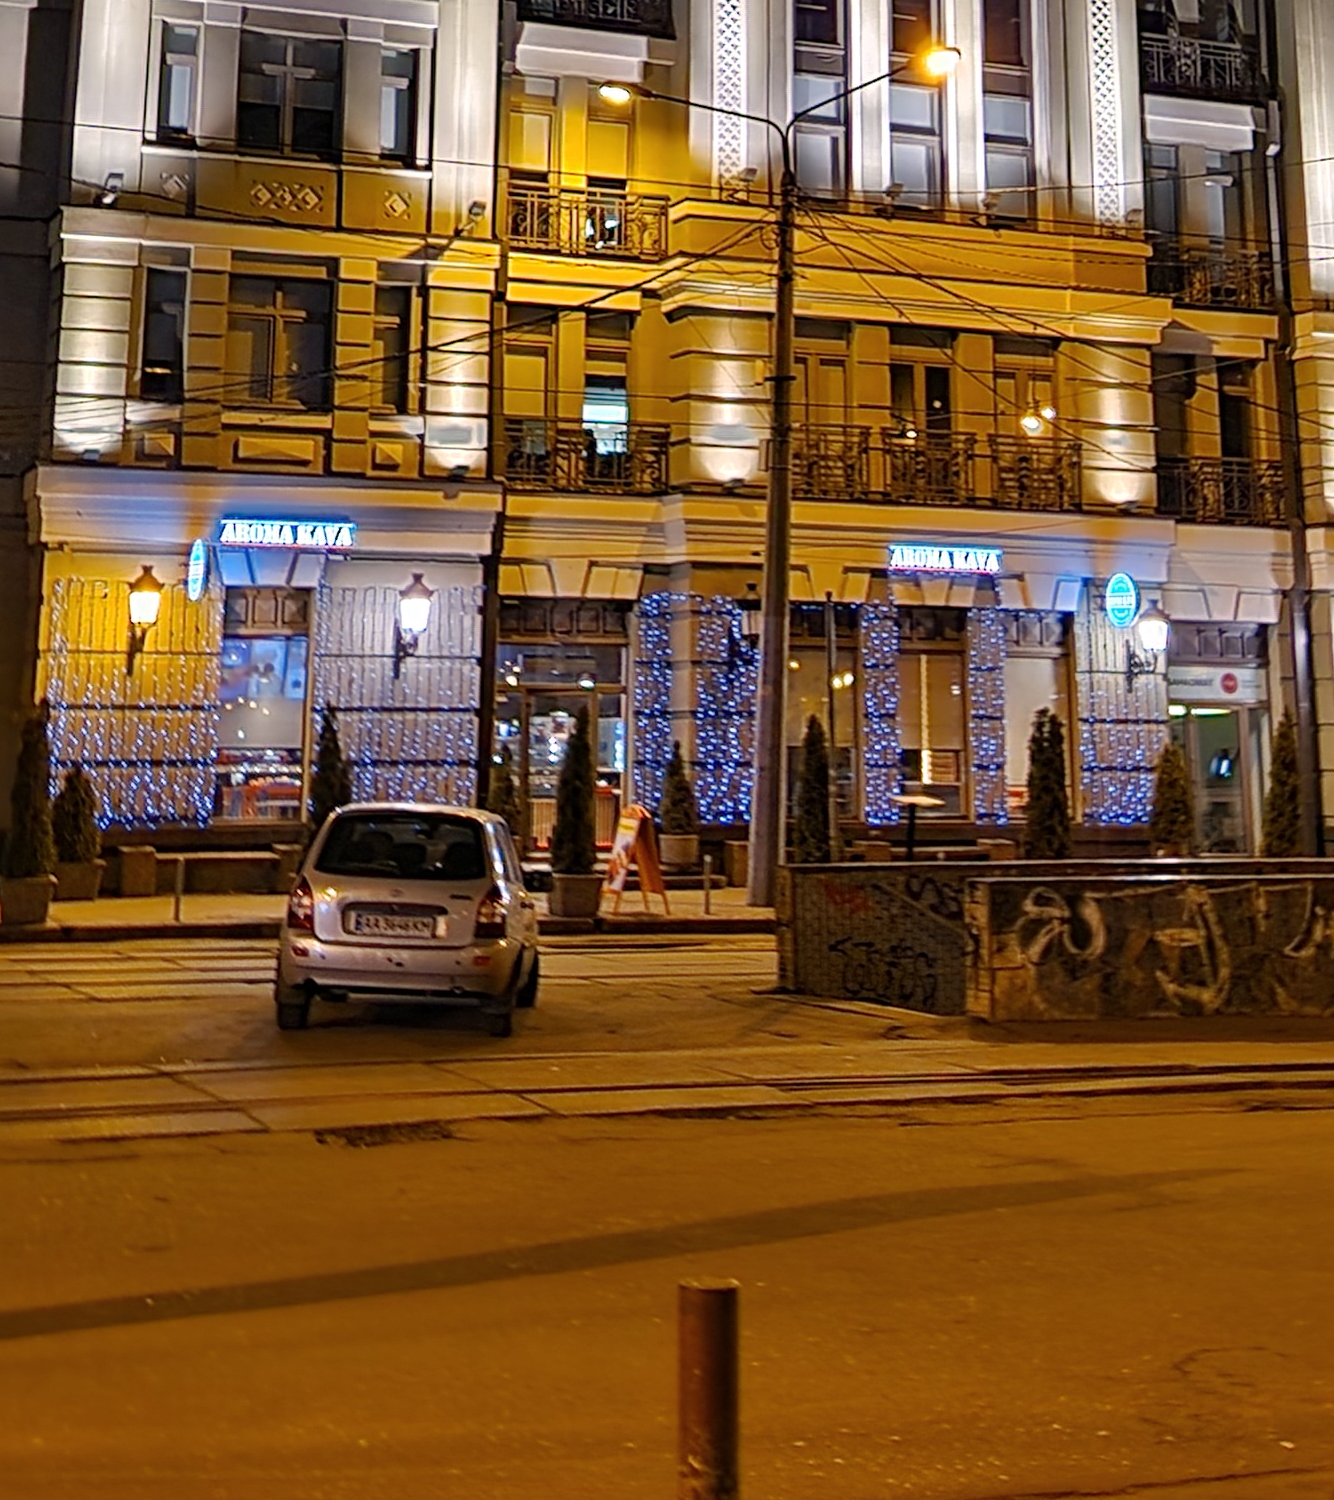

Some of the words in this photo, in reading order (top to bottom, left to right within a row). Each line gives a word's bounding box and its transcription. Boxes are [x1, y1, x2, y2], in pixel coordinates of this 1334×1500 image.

[220, 523, 294, 545] AROMA
[296, 525, 353, 547] KAVA
[889, 548, 952, 569] AROMA
[953, 550, 1000, 572] KAVA
